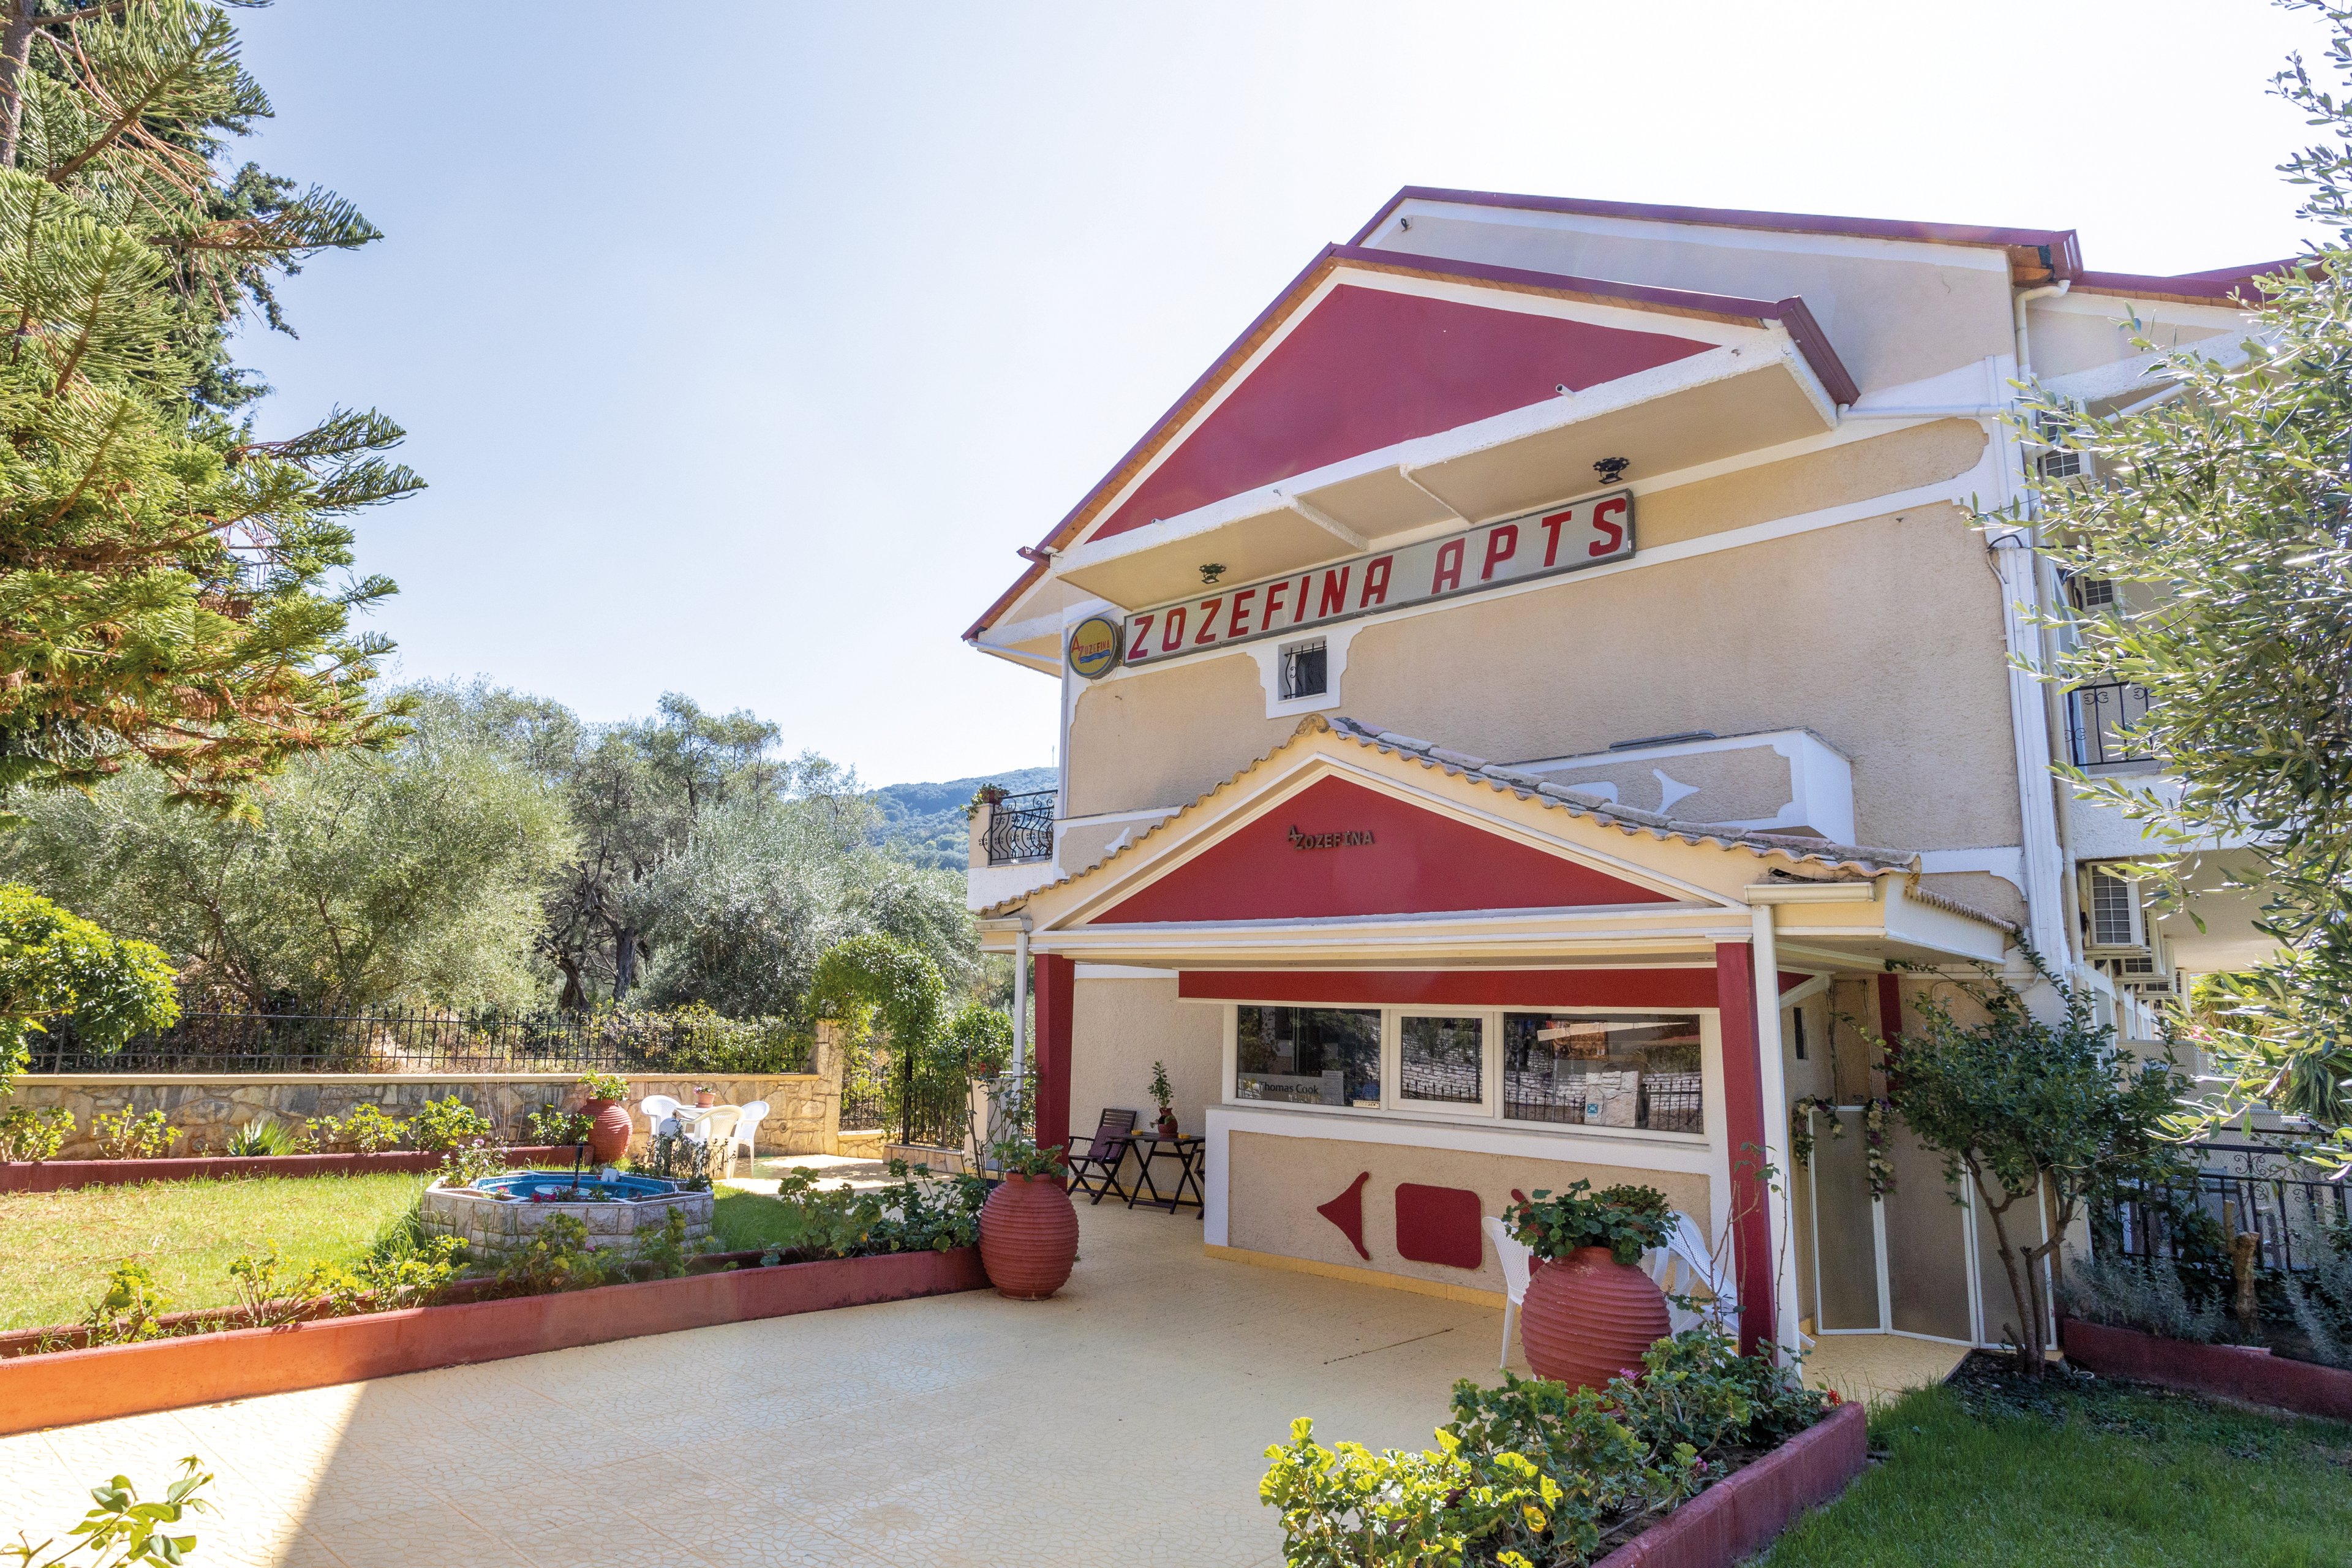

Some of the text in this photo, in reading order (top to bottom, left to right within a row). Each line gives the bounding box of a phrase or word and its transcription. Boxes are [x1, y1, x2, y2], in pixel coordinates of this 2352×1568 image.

[1128, 497, 1627, 660] ZOZEFINA APTS
[1259, 1080, 1319, 1094] Thomas Cook
